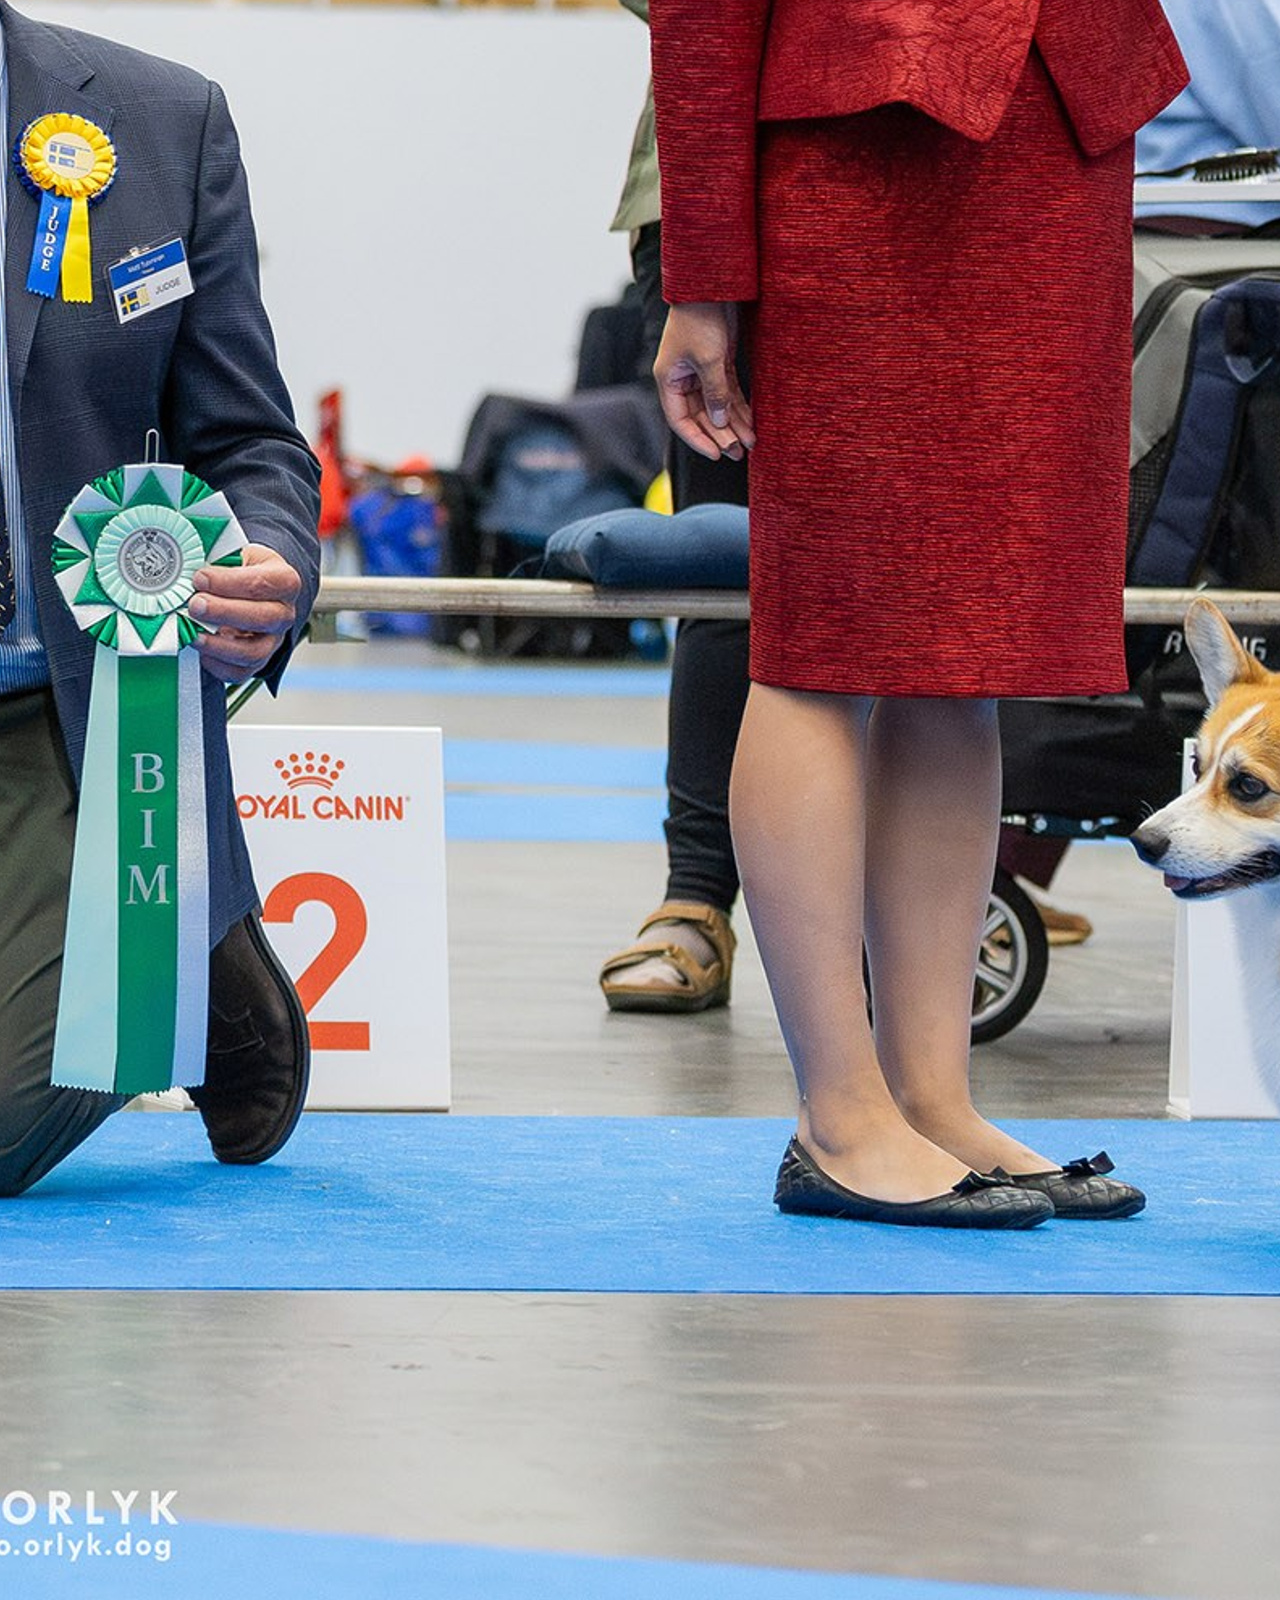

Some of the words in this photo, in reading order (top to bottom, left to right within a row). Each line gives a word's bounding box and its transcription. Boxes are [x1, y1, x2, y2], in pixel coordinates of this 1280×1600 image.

[41, 205, 59, 271] JUDGE
[155, 277, 181, 295] JUDGE
[125, 753, 170, 904] BIM
[236, 795, 306, 820] OYAL
[312, 795, 403, 821] CANIN
[262, 872, 368, 1051] 2
